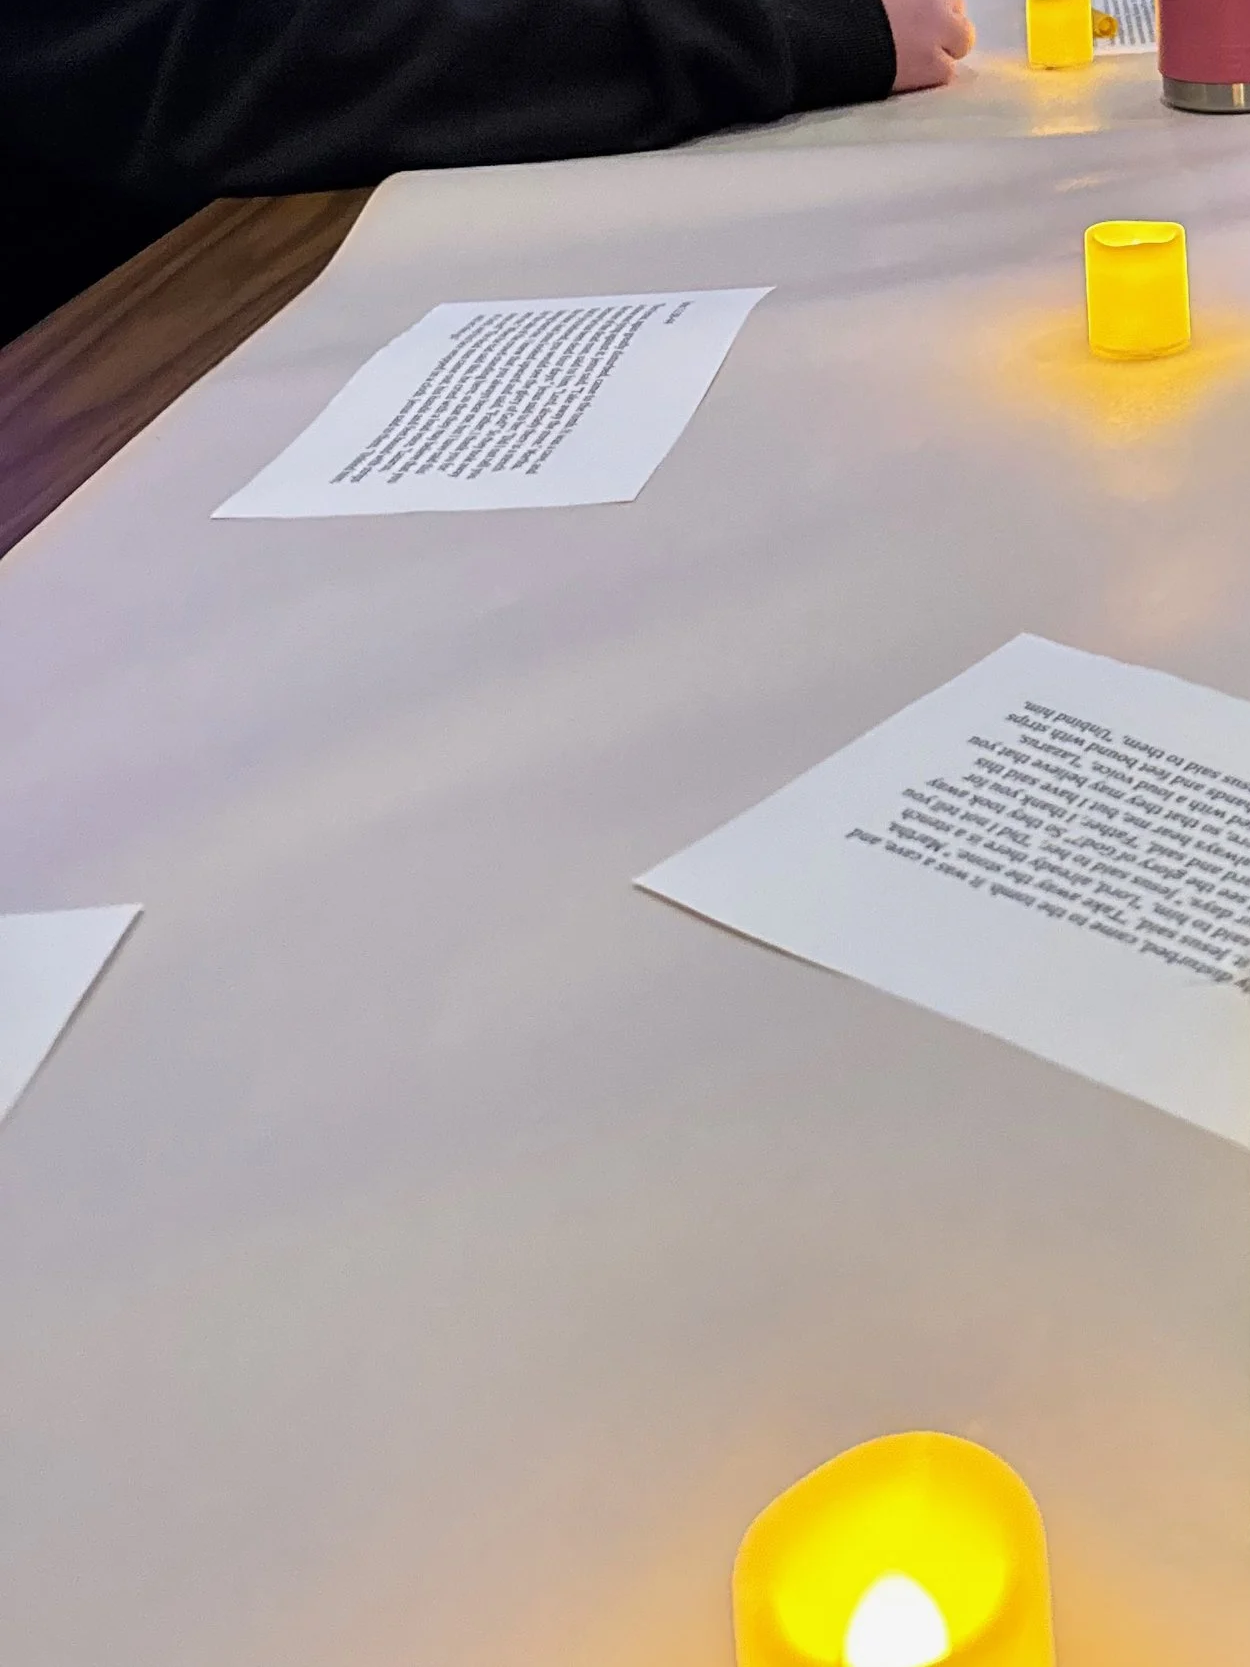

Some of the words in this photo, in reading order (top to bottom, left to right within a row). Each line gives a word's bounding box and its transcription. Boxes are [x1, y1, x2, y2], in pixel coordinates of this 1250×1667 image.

[1005, 713, 1051, 733] strips
[967, 735, 1003, 752] you
[1050, 728, 1086, 747] with
[997, 746, 1031, 765] that
[1083, 742, 1139, 770] bound
[974, 757, 1006, 775] this
[1030, 759, 1089, 789] believe
[1137, 762, 1172, 781] feet
[1182, 761, 1222, 779] said
[961, 773, 990, 789] for
[1001, 768, 1041, 787] said
[1168, 775, 1205, 792] and
[901, 788, 939, 805] you
[925, 777, 971, 798] away
[987, 781, 1025, 799] you
[1039, 782, 1081, 805] have
[1087, 780, 1126, 800] may
[1132, 780, 1175, 802] loud
[968, 794, 1007, 815] took
[1019, 794, 1068, 819] thank
[1088, 801, 1120, 820] but
[1124, 795, 1164, 815] they
[1188, 800, 1226, 819] with
[901, 808, 955, 833] stench
[959, 811, 990, 827] not
[1006, 808, 1044, 830] they
[1163, 810, 1200, 829] that
[845, 828, 883, 845] and
[1150, 825, 1193, 847] hear
[982, 840, 1029, 863] there
[935, 863, 968, 881] was
[1027, 857, 1094, 886] already
[1089, 861, 1131, 880] said
[1136, 858, 1188, 880] glory
[1183, 857, 1224, 875] and
[1003, 869, 1034, 885] the
[1185, 877, 1216, 894] the
[1129, 875, 1181, 901] Jesus
[1217, 889, 1249, 904] see
[1036, 901, 1067, 919] the
[1089, 922, 1138, 944] came
[1178, 935, 1232, 962] Jesus
